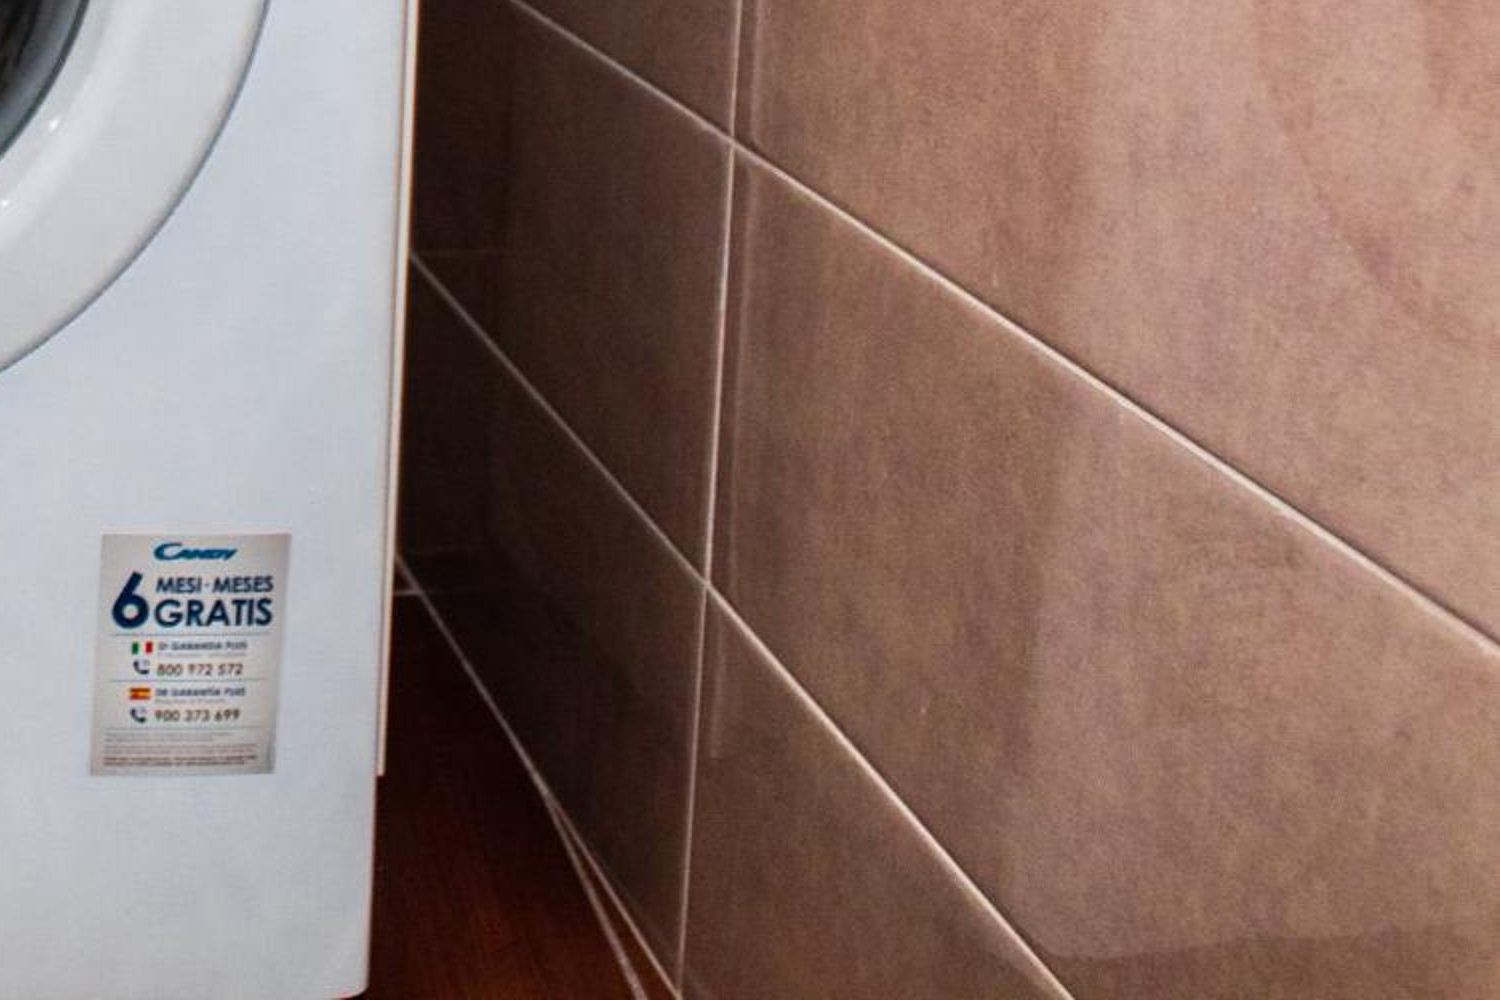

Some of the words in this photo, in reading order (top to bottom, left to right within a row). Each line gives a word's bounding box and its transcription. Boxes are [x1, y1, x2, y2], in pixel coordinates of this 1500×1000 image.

[112, 572, 149, 629] 6
[154, 598, 273, 627] GRATIS
[157, 663, 182, 676] 800
[188, 663, 213, 676] 972
[218, 663, 244, 676] 572
[155, 709, 180, 722] 900
[215, 709, 240, 722] 699
